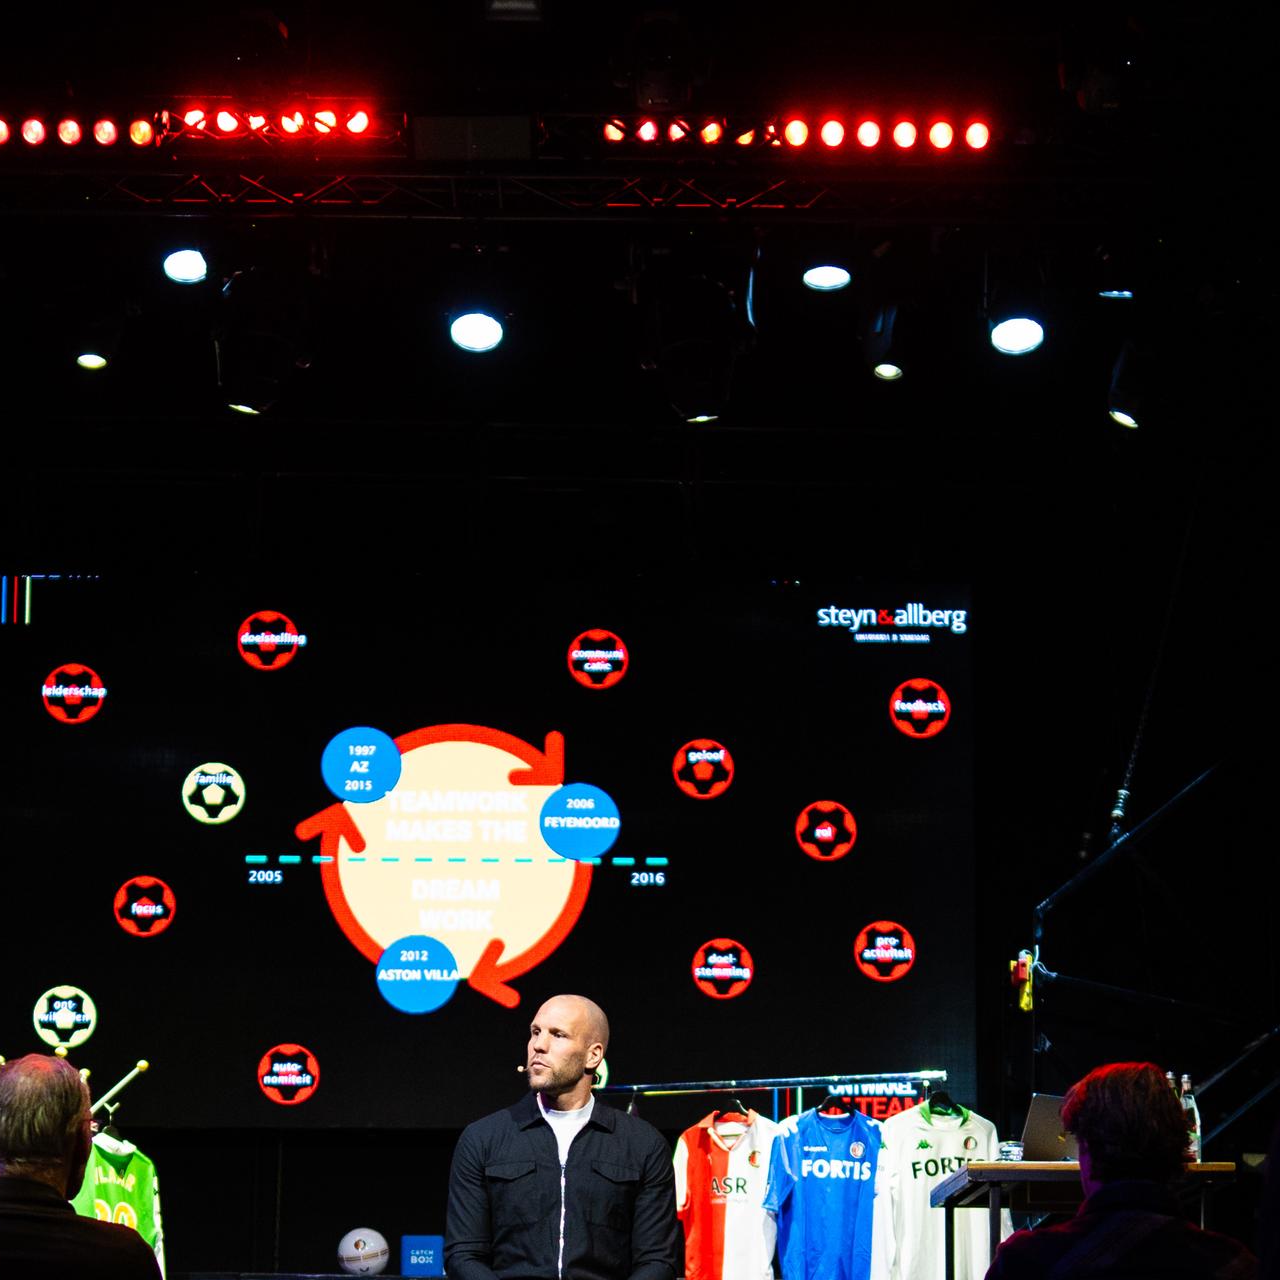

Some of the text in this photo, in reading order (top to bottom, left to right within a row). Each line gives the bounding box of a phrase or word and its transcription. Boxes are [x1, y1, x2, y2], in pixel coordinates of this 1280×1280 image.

[817, 603, 968, 633] steyn&allberg
[42, 685, 106, 698] leiderschap
[894, 700, 945, 712] feedback
[349, 745, 376, 755] 1997
[350, 761, 369, 772] AZ
[344, 780, 372, 790] 2015
[386, 790, 528, 813] TEAMWORK
[566, 799, 595, 810] 2006
[544, 816, 620, 828] FEYENOORD
[385, 820, 528, 843] MAKES THE
[248, 870, 282, 883] 2005
[631, 872, 665, 885] 2016
[412, 879, 500, 901] DREAM
[131, 903, 163, 915] focus
[419, 910, 494, 932] WORK
[875, 936, 899, 948] pro-
[400, 950, 428, 961] 2012
[378, 969, 460, 981] ASTON VILLA
[695, 967, 751, 979] stemming
[272, 1062, 302, 1072] auto-
[802, 1159, 871, 1181] FORTIS
[911, 1157, 985, 1179] FORT
[711, 1177, 747, 1194] ASR
[411, 1256, 433, 1264] BOX
